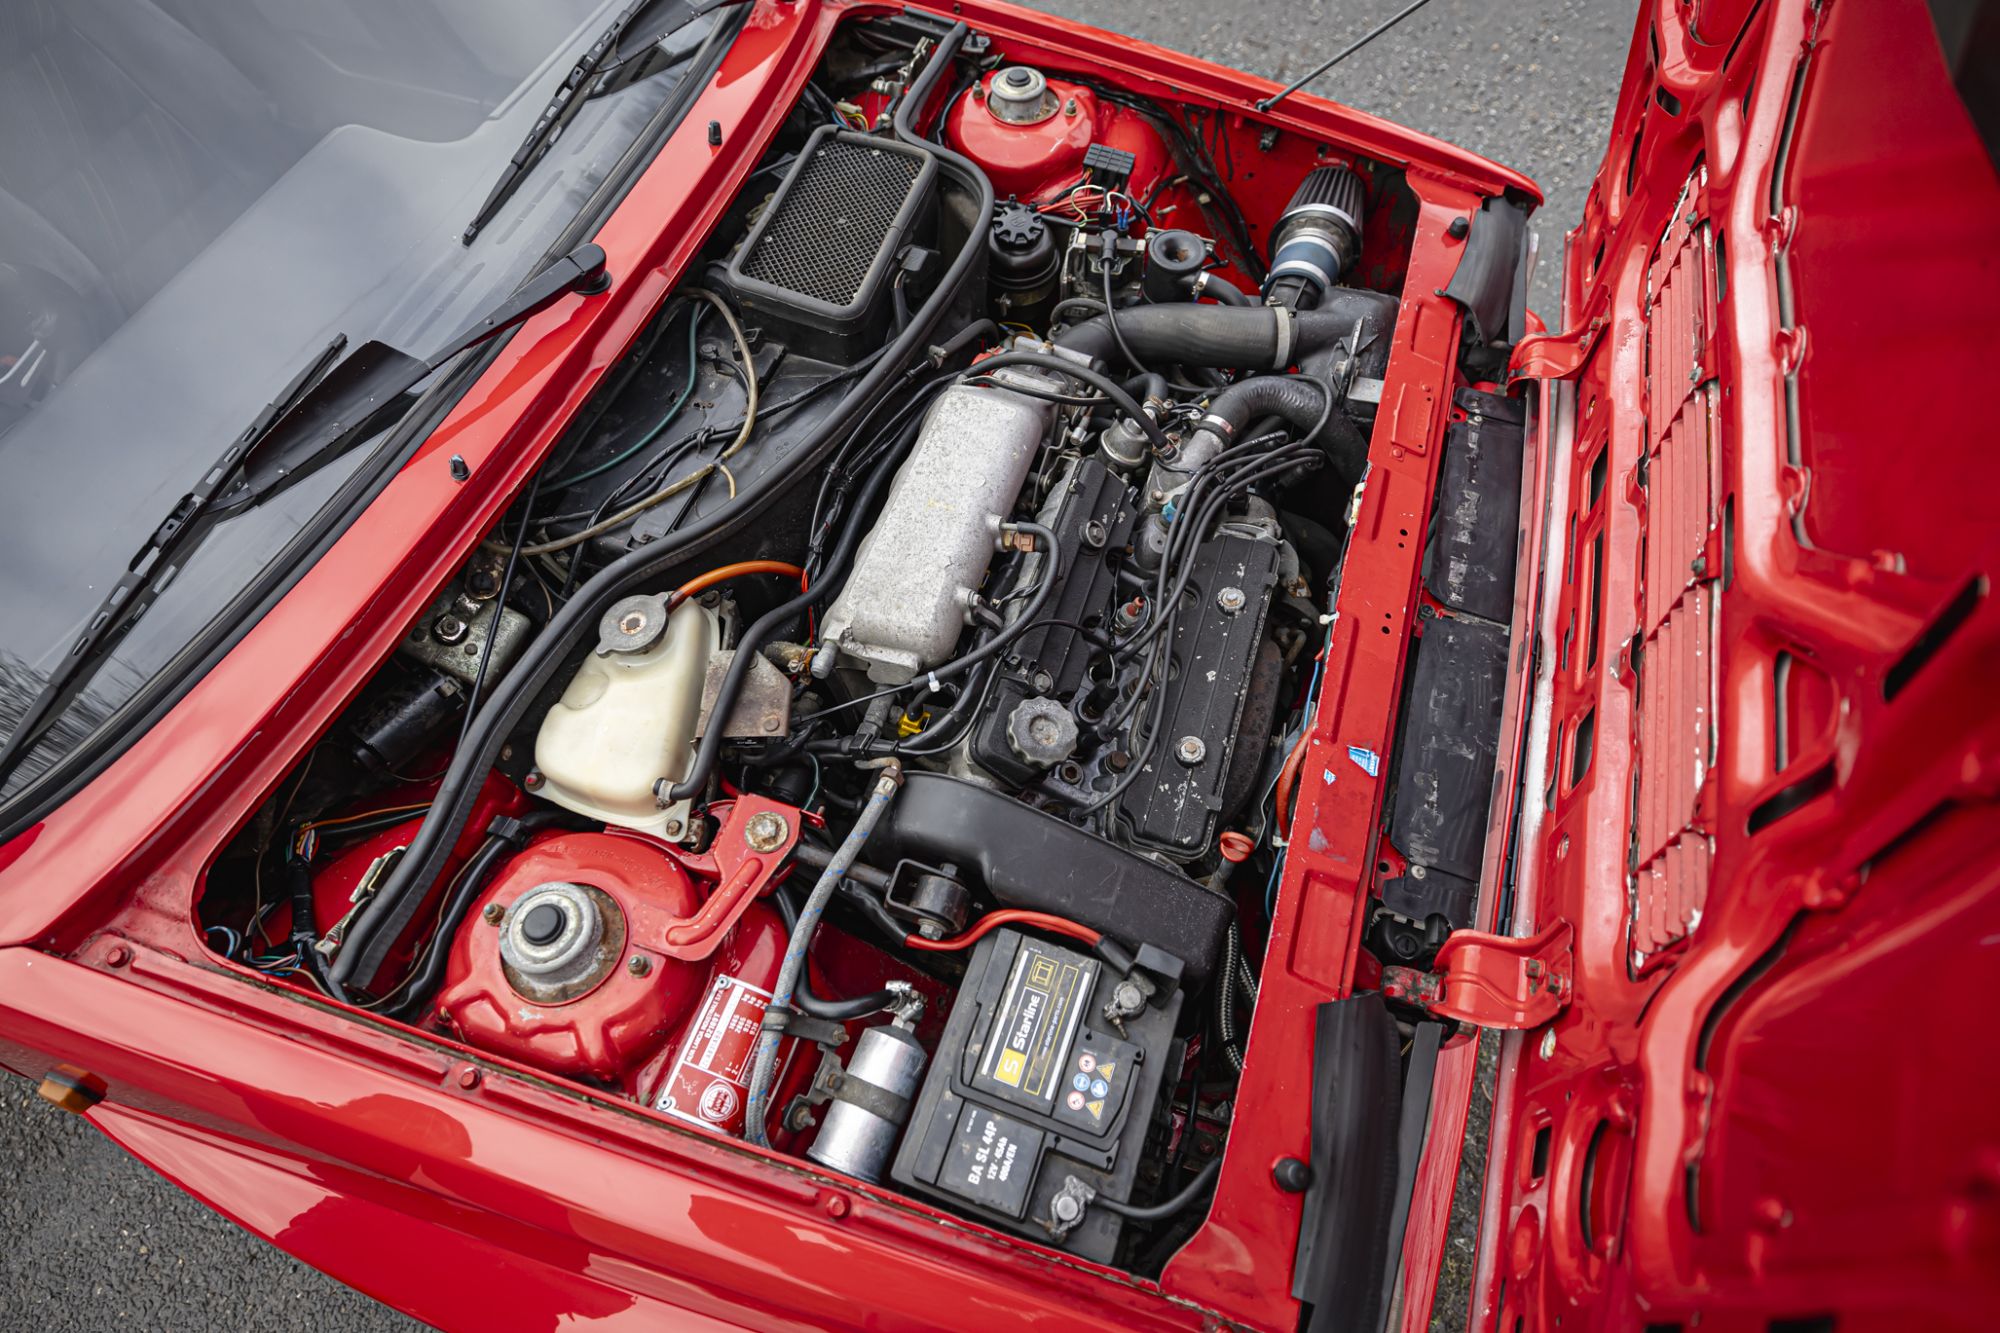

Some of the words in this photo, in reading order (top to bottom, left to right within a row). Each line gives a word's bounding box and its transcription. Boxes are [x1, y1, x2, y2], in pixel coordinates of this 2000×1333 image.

[1012, 994, 1041, 1051] Starline
[982, 1120, 997, 1145] 44P
[975, 1147, 991, 1163] SL
[986, 1162, 999, 1180] 12V
[994, 1136, 1008, 1159] 45Ah
[967, 1164, 984, 1185] BA
